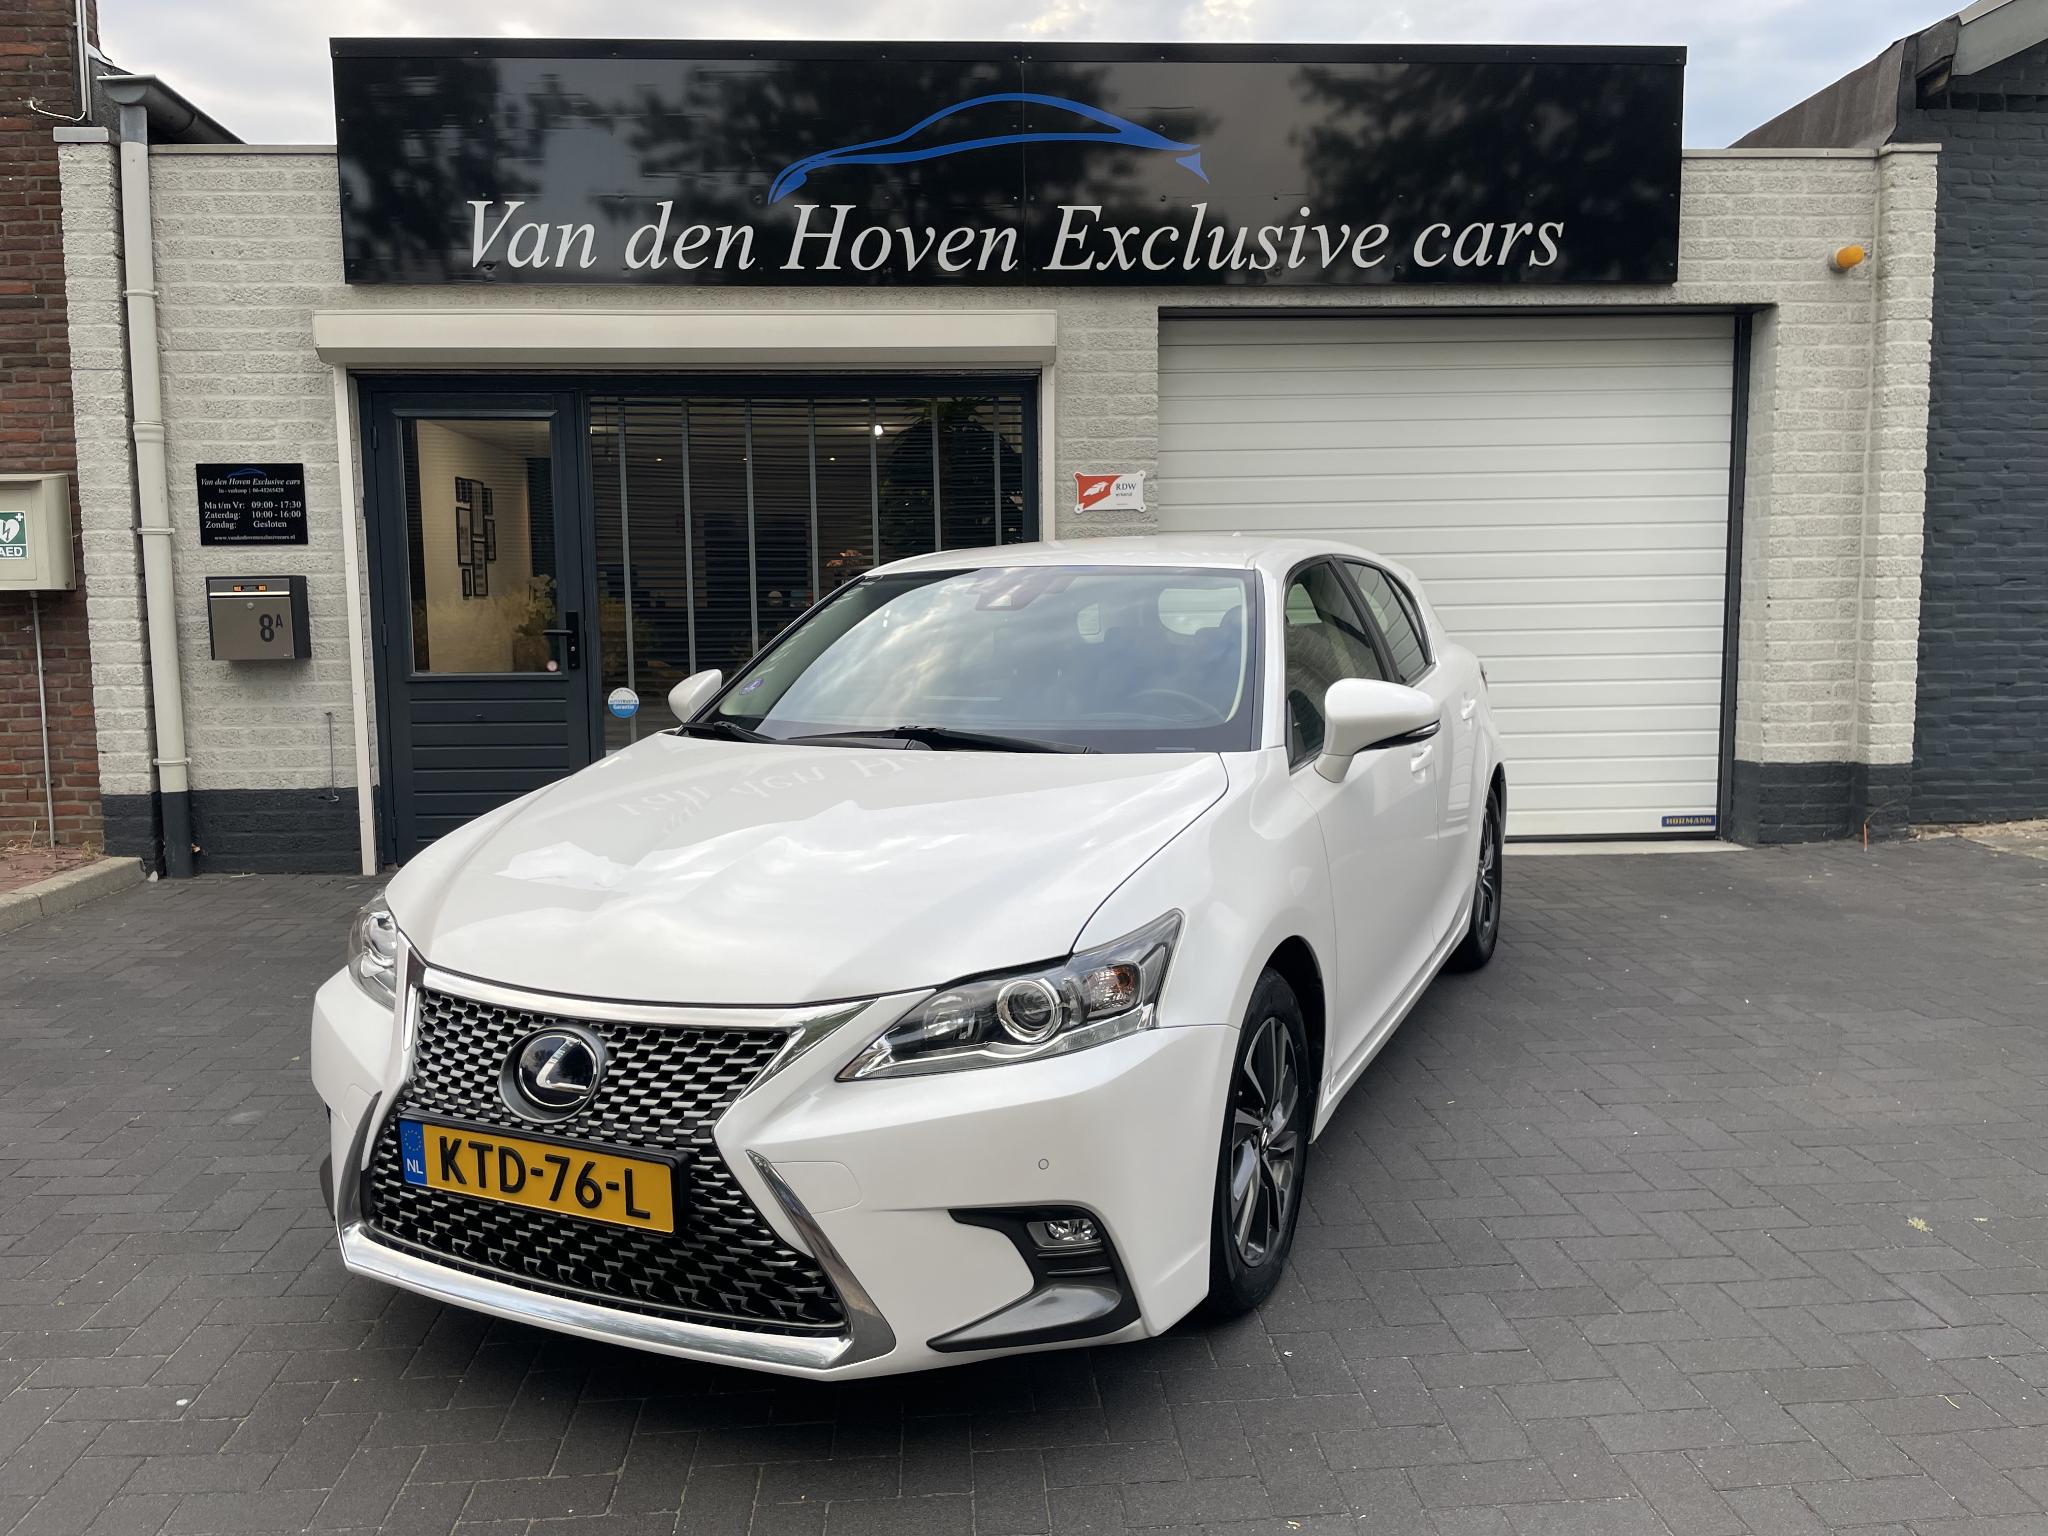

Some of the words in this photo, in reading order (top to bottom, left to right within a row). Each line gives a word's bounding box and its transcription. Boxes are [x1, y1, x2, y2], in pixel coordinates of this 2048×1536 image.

[466, 200, 597, 269] Van
[624, 200, 756, 270] den
[779, 204, 1019, 271] Hoven
[1042, 202, 1390, 271] Exclusive
[1413, 220, 1565, 268] cars
[201, 478, 214, 486] Van
[214, 478, 227, 486] den
[228, 478, 251, 486] Hoven
[252, 477, 285, 486] Exclusive
[1115, 483, 1137, 491] RDW
[204, 501, 217, 509] Ma
[218, 501, 231, 509] t/m
[232, 501, 245, 509] Vr:
[251, 501, 274, 509] 09:00
[280, 500, 302, 508] 17:30
[204, 511, 241, 520] Zaterdag:
[252, 510, 273, 518] 10:00
[280, 510, 301, 518] 16:00
[205, 521, 237, 530] Zondag:
[253, 520, 287, 528] Gesloten
[0, 546, 22, 557] AED
[406, 1158, 424, 1175] NL
[439, 1136, 650, 1219] KTD-76-L
